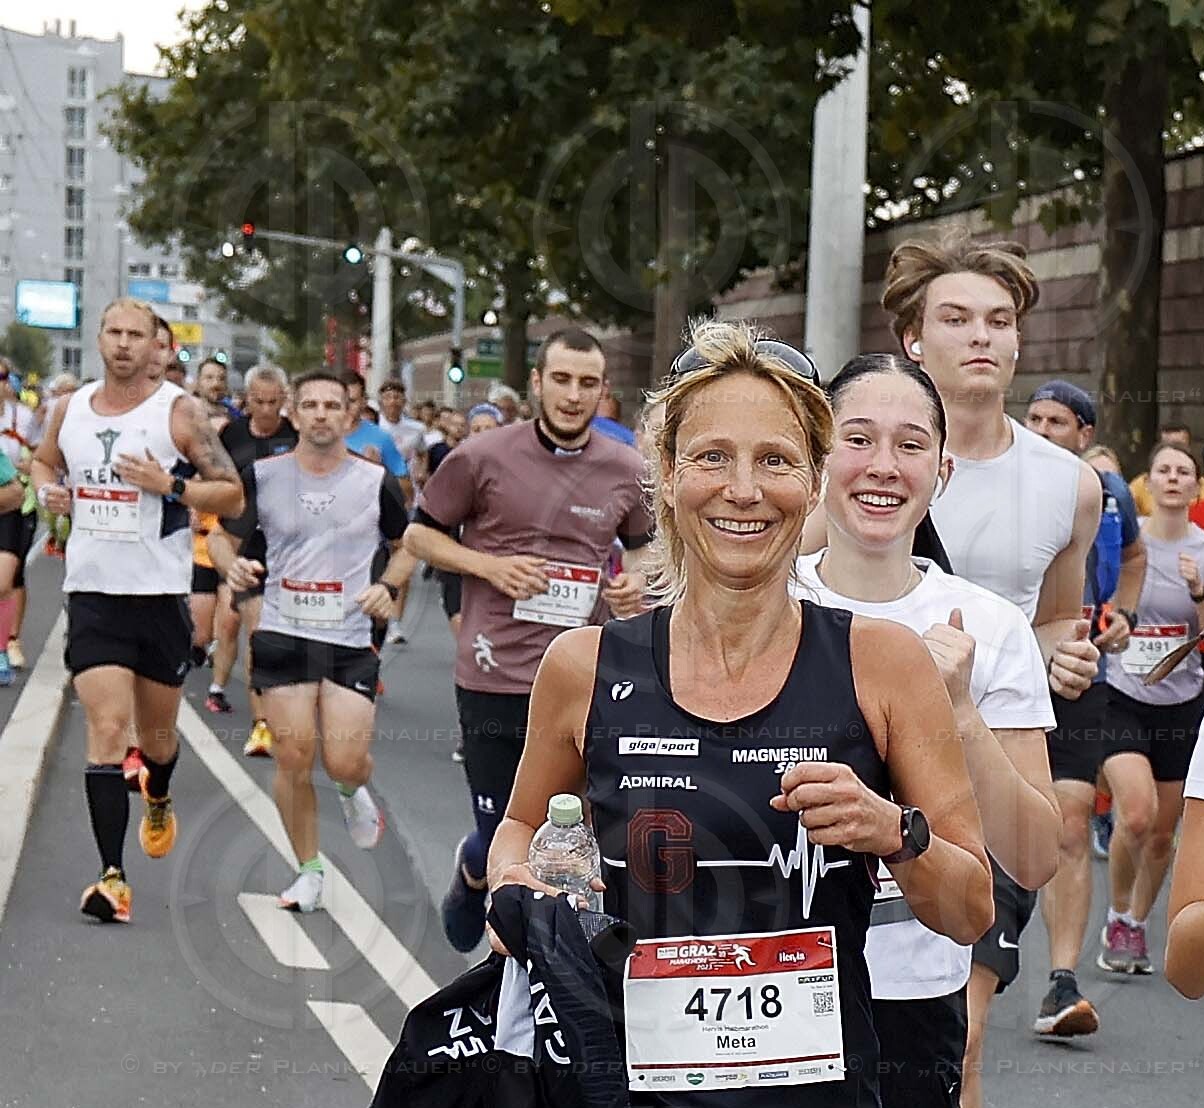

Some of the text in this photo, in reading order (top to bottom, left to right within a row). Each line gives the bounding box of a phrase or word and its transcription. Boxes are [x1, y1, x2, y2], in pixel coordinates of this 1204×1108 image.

[548, 584, 580, 600] 931
[294, 594, 325, 607] 6458
[1139, 641, 1169, 652] 2491
[732, 747, 828, 763] MAGNESIUM
[619, 775, 698, 790] ADMIRAL
[679, 944, 717, 958] GRAZ
[684, 984, 783, 1021] 4718
[716, 1035, 756, 1049] Meta
